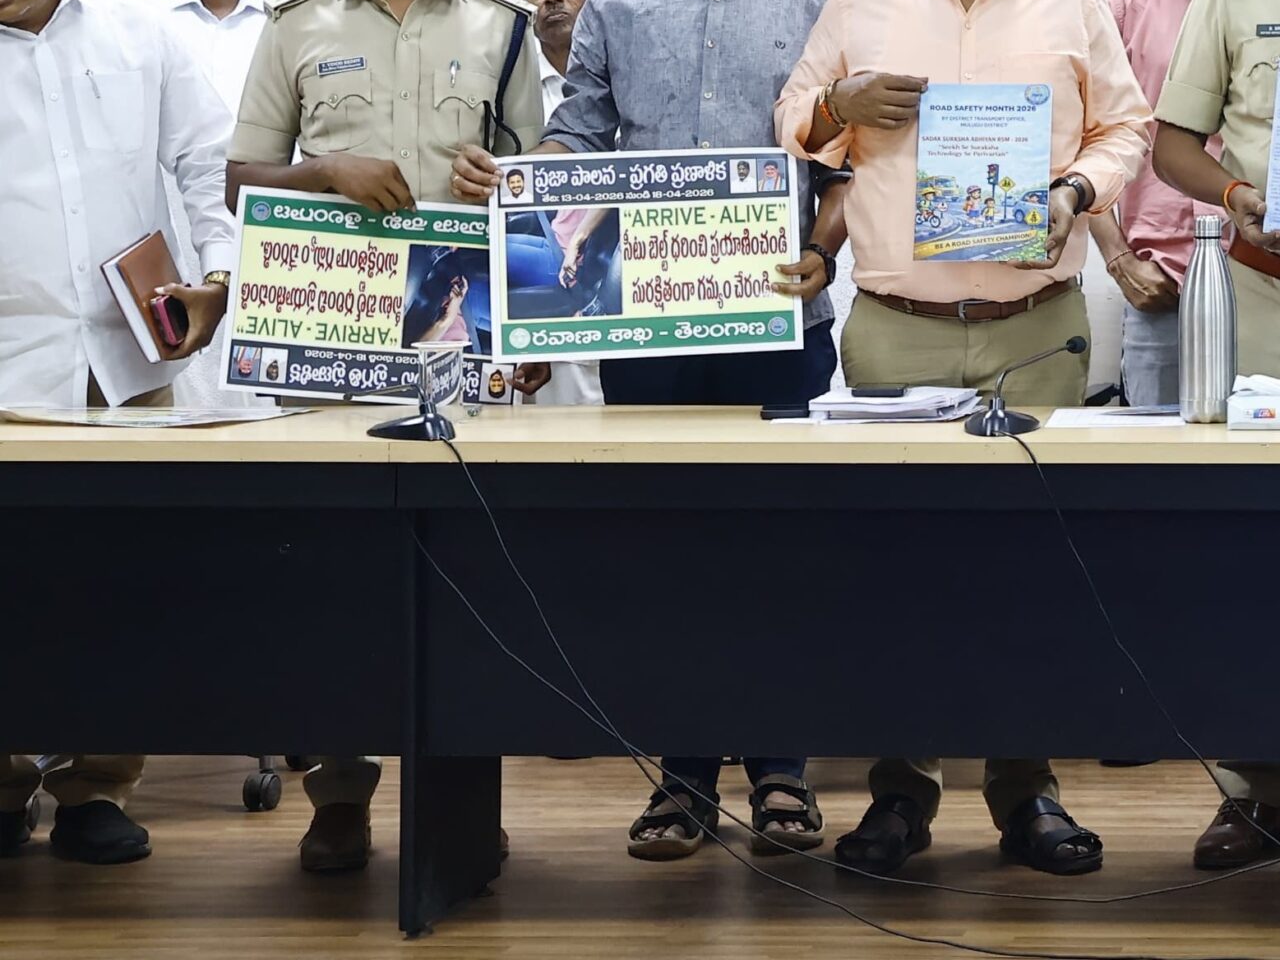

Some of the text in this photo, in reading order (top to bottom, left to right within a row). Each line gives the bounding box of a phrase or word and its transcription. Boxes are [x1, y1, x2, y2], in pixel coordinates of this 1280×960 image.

[534, 168, 568, 193] ప్రజా
[571, 165, 616, 186] పాలన
[629, 163, 668, 190] ప్రగతి
[671, 161, 727, 188] ప్రణాళిక
[561, 192, 624, 201] 13-04-2026
[652, 189, 714, 198] 18-04-2026
[273, 205, 361, 229] తెలంగాణ
[433, 219, 489, 238] వాణా
[624, 229, 646, 260] సీటు
[671, 234, 707, 262] ధరించి
[532, 328, 601, 347] రవాణా
[607, 328, 653, 345] శాఖ
[674, 322, 766, 339] తెలంగాణ
[305, 350, 366, 361] 18-04-2026
[349, 364, 388, 389] ప్రగతి
